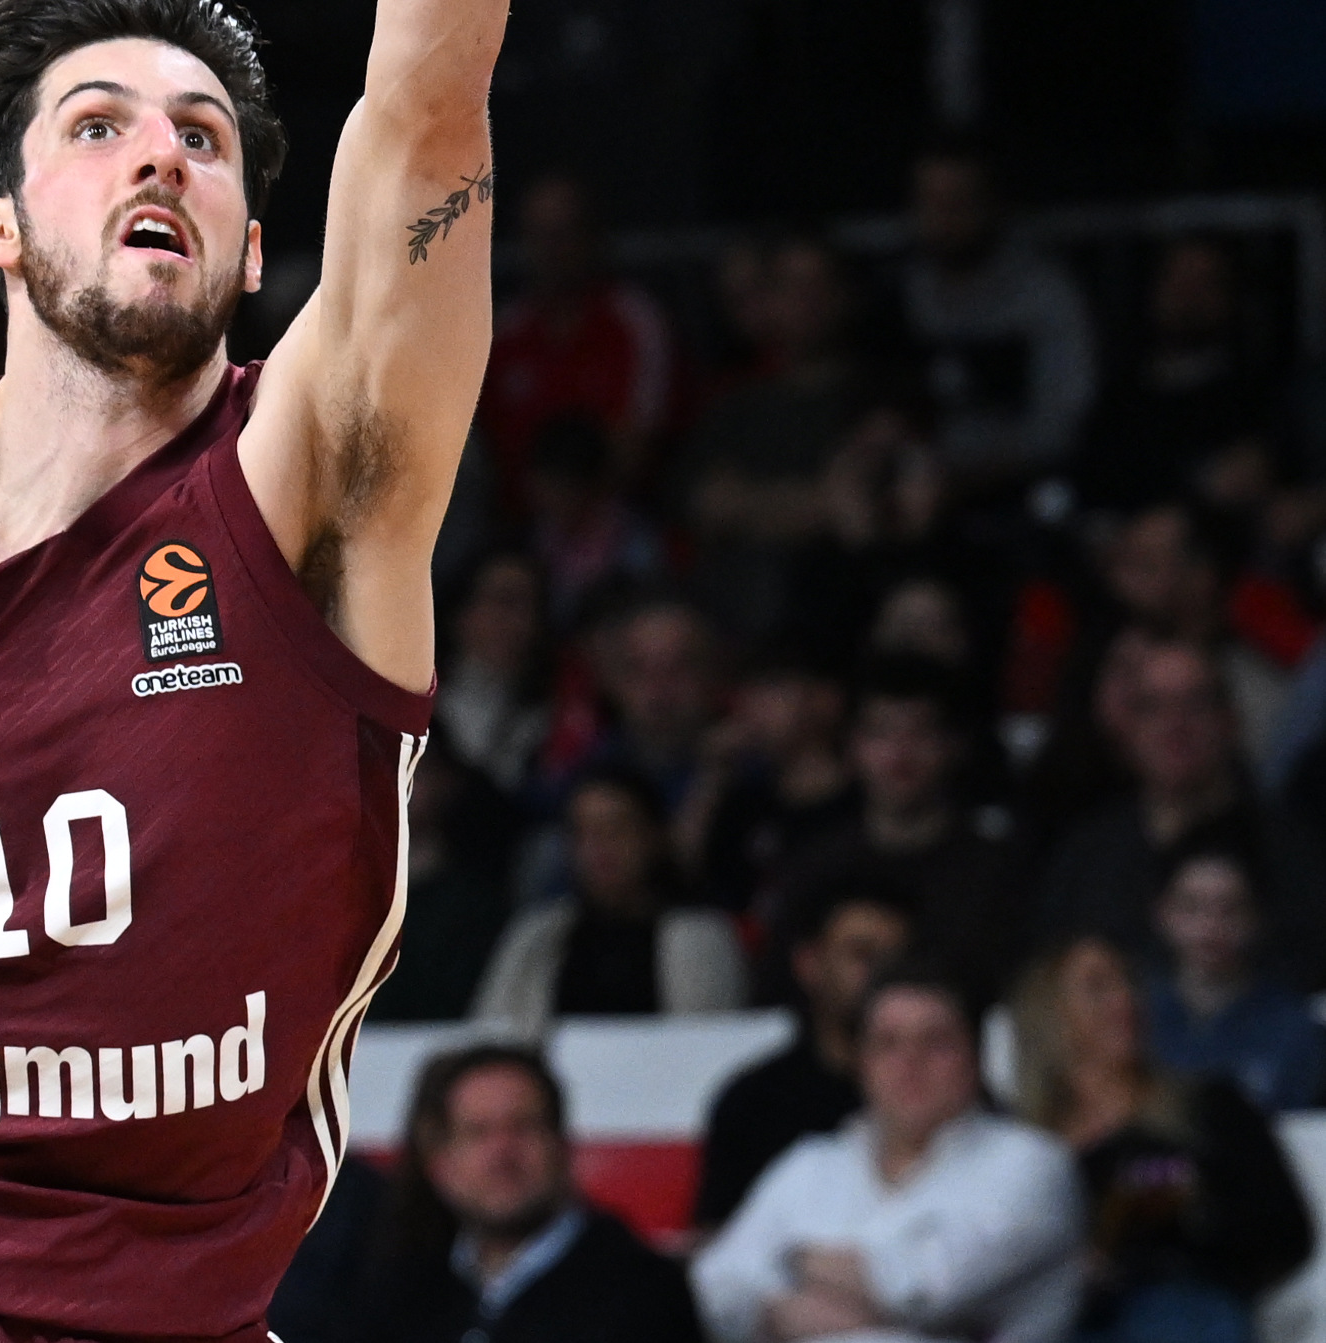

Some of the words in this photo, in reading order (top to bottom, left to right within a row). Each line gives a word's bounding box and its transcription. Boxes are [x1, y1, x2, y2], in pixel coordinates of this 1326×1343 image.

[148, 614, 213, 636] TURKISH
[150, 626, 215, 648] AIRLINES
[150, 640, 217, 658] EuroLeague
[135, 666, 240, 694] oneteam
